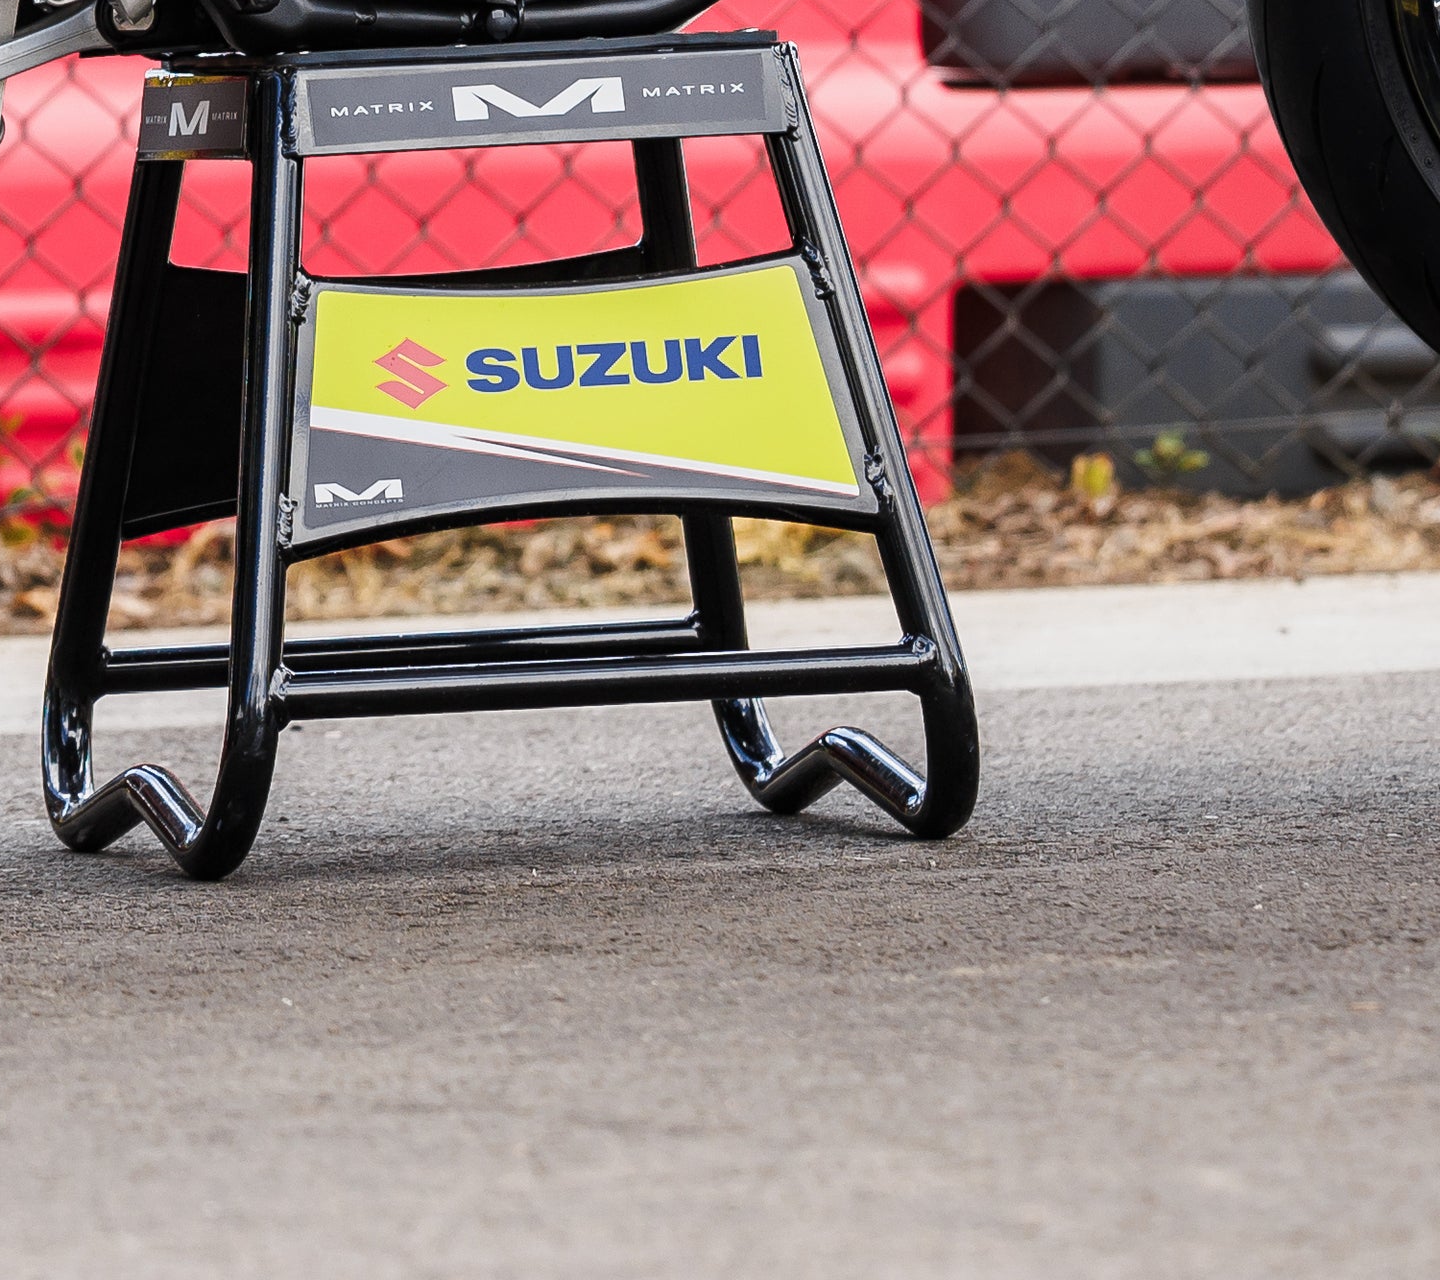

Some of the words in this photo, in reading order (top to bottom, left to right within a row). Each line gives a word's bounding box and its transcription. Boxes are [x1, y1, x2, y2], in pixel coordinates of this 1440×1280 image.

[211, 111, 239, 121] MATRIX
[330, 100, 435, 118] MATRIX
[641, 82, 746, 98] MATRIX
[465, 334, 762, 393] SUZUKI
